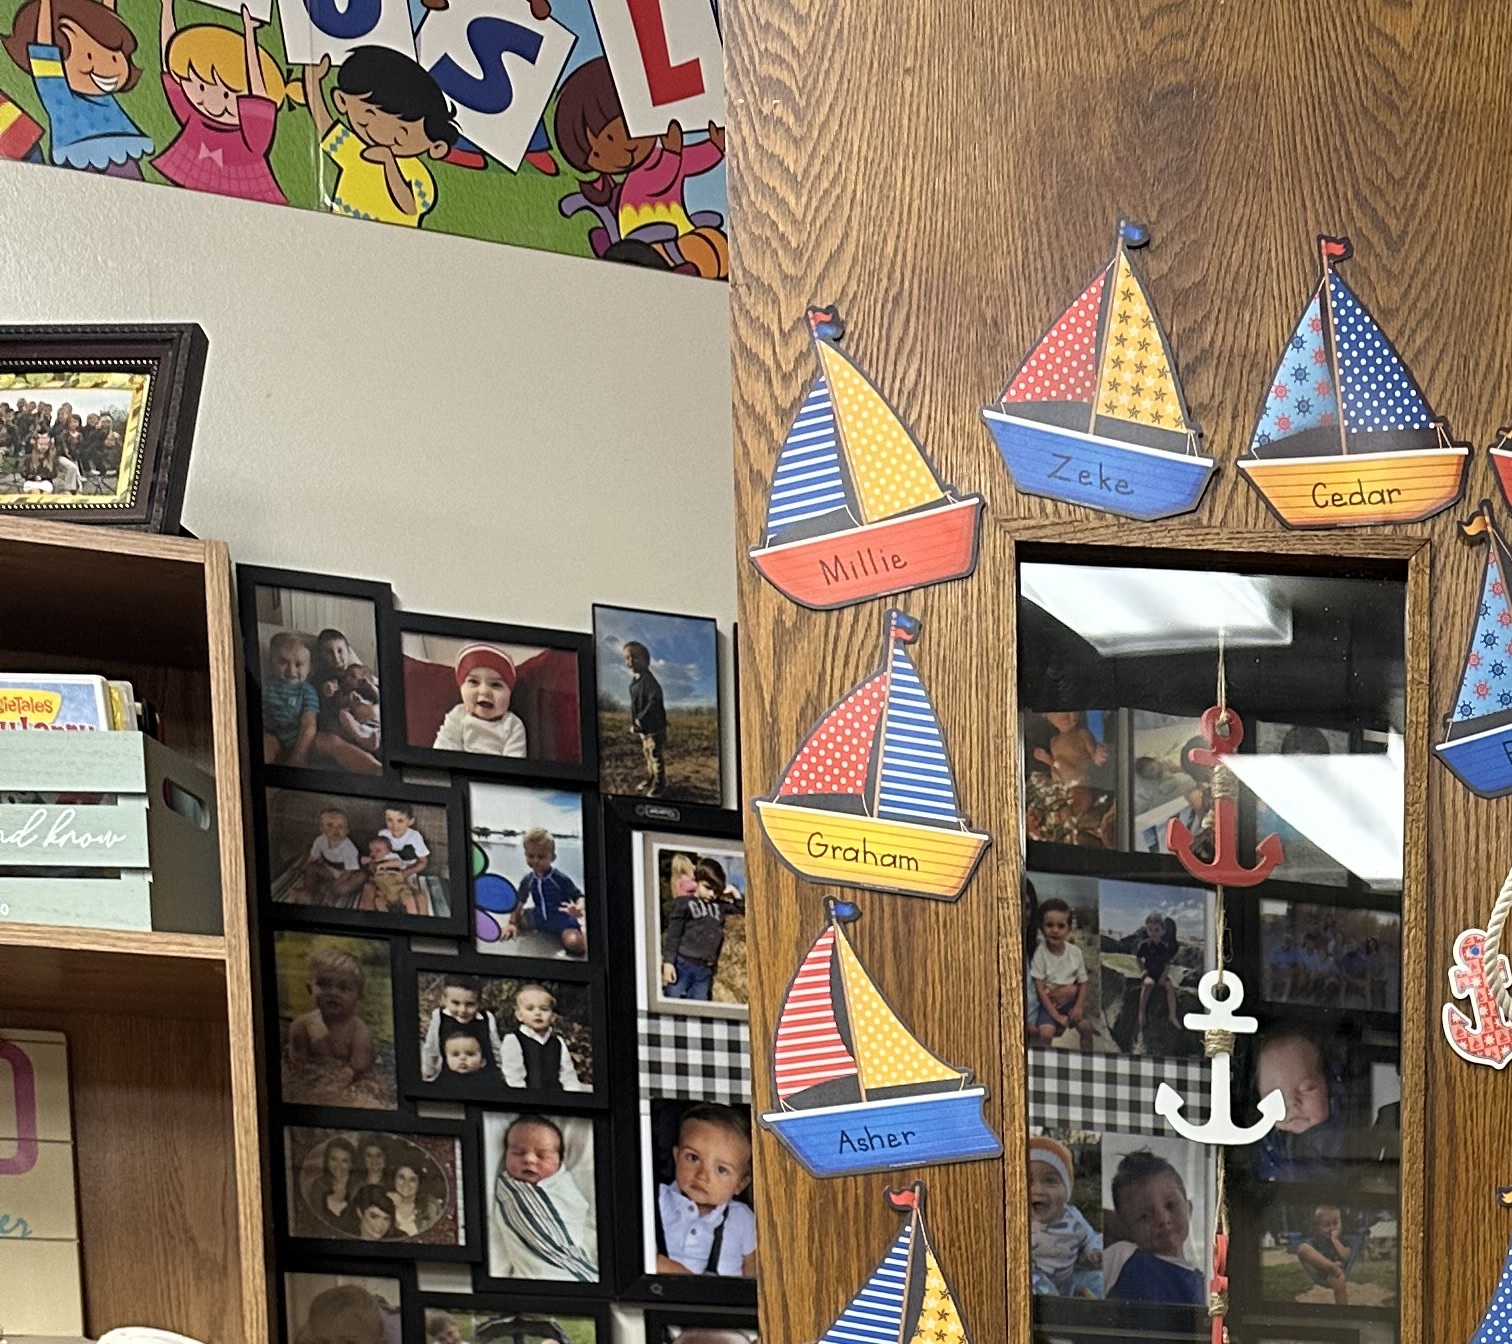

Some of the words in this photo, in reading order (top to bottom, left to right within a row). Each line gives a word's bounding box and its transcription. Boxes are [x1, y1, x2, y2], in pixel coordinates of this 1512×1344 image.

[1047, 453, 1134, 496] Zeke
[1311, 479, 1402, 509] Cedar
[818, 550, 908, 586] Millie
[43, 808, 126, 848] know
[807, 831, 919, 873] Graham
[838, 1127, 916, 1155] Asher
